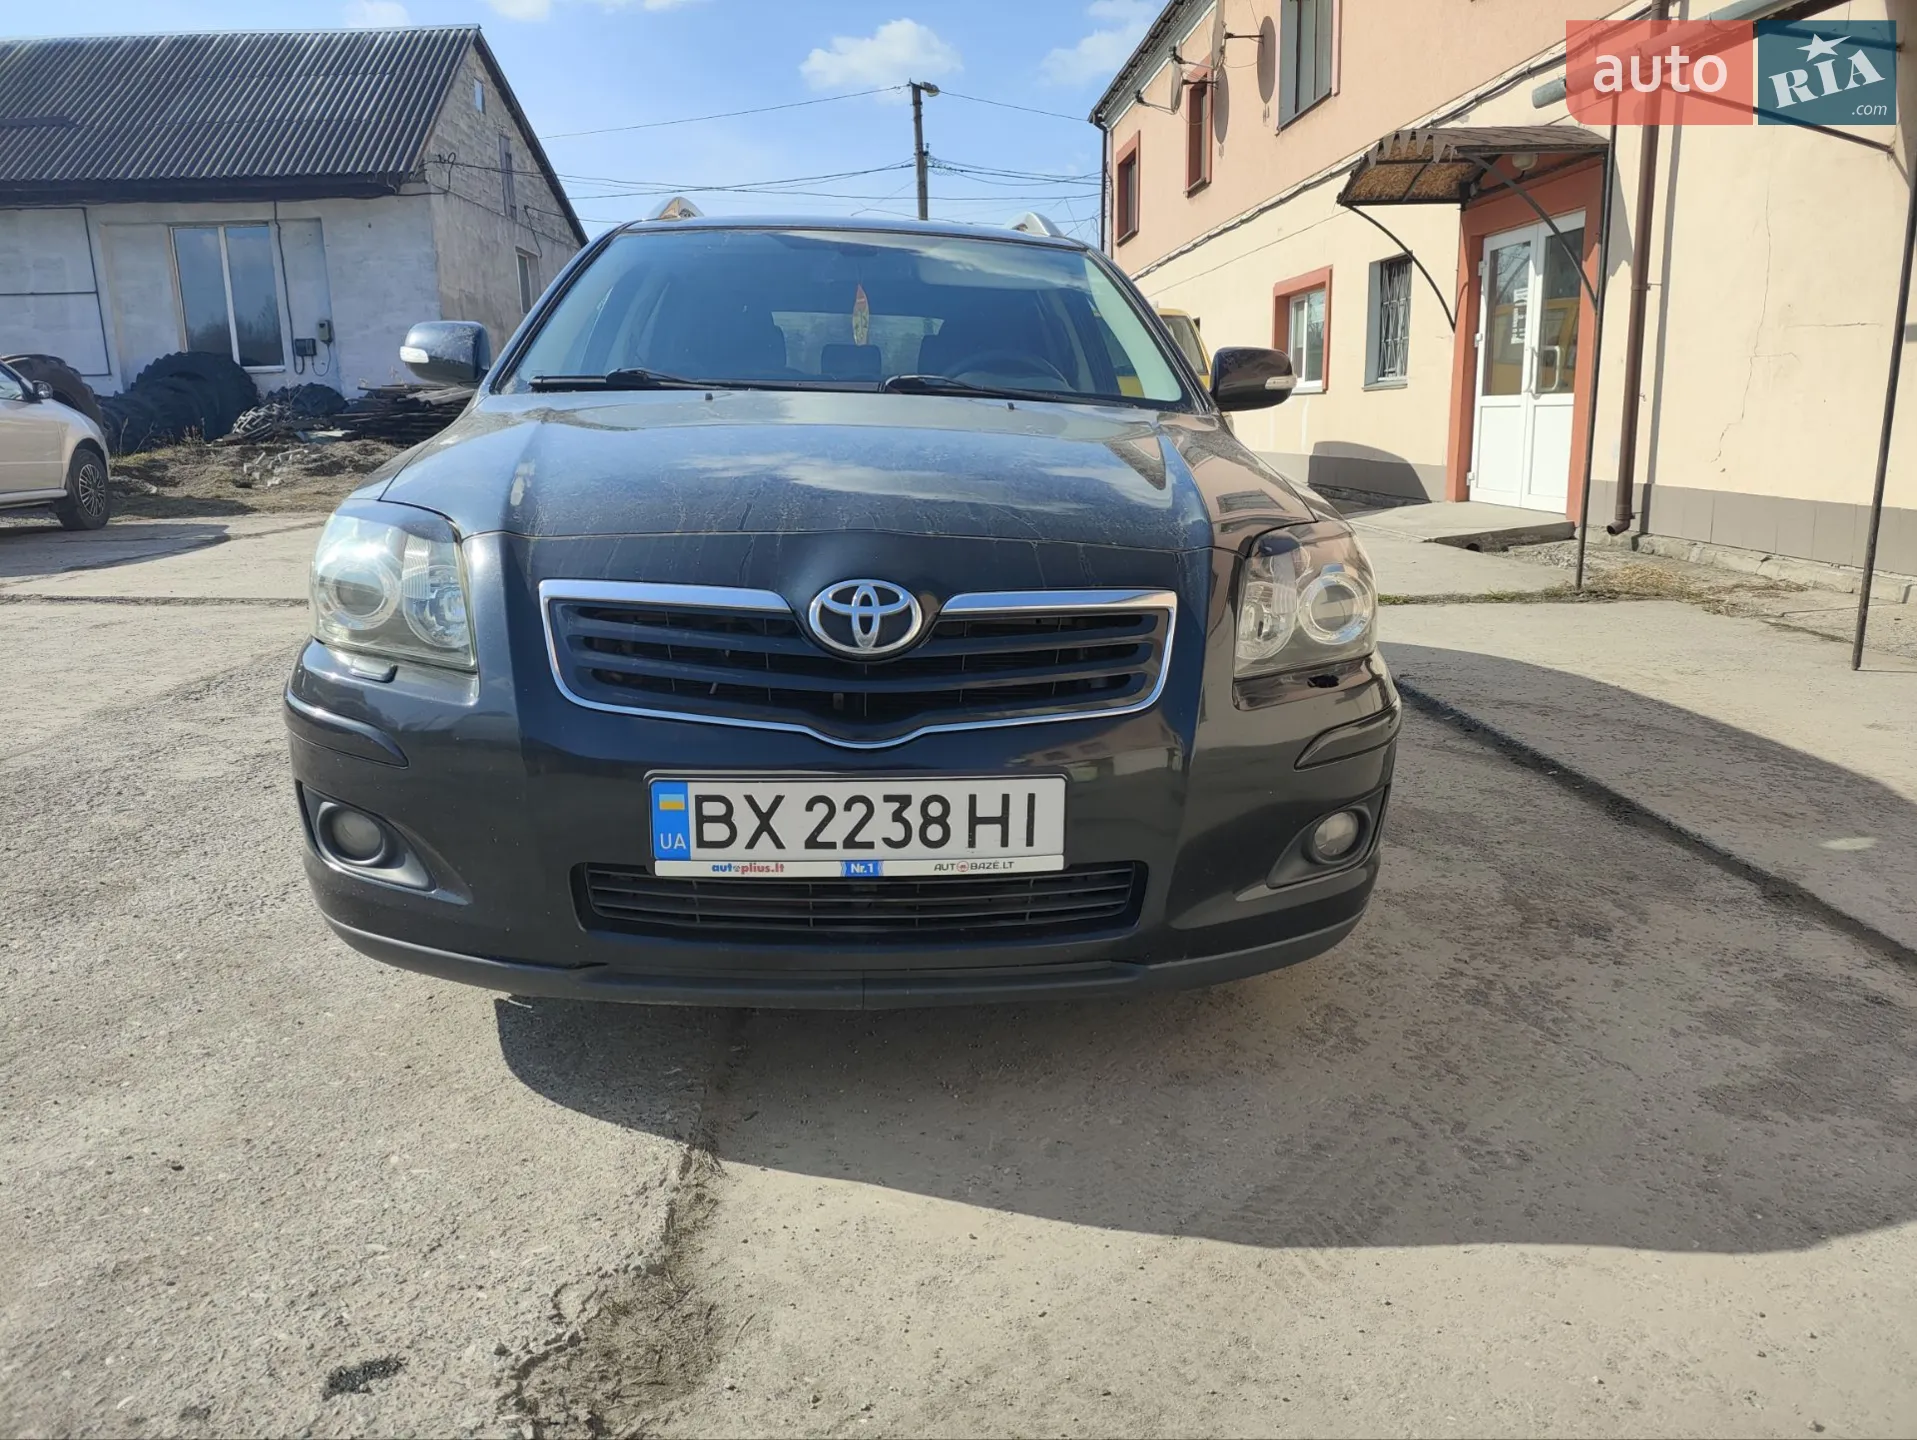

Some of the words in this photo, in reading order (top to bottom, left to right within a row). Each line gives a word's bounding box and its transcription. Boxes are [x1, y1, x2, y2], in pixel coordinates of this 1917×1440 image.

[695, 794, 786, 850] BX
[804, 794, 951, 850] 2238
[967, 793, 1035, 849] HI
[660, 832, 687, 850] UA
